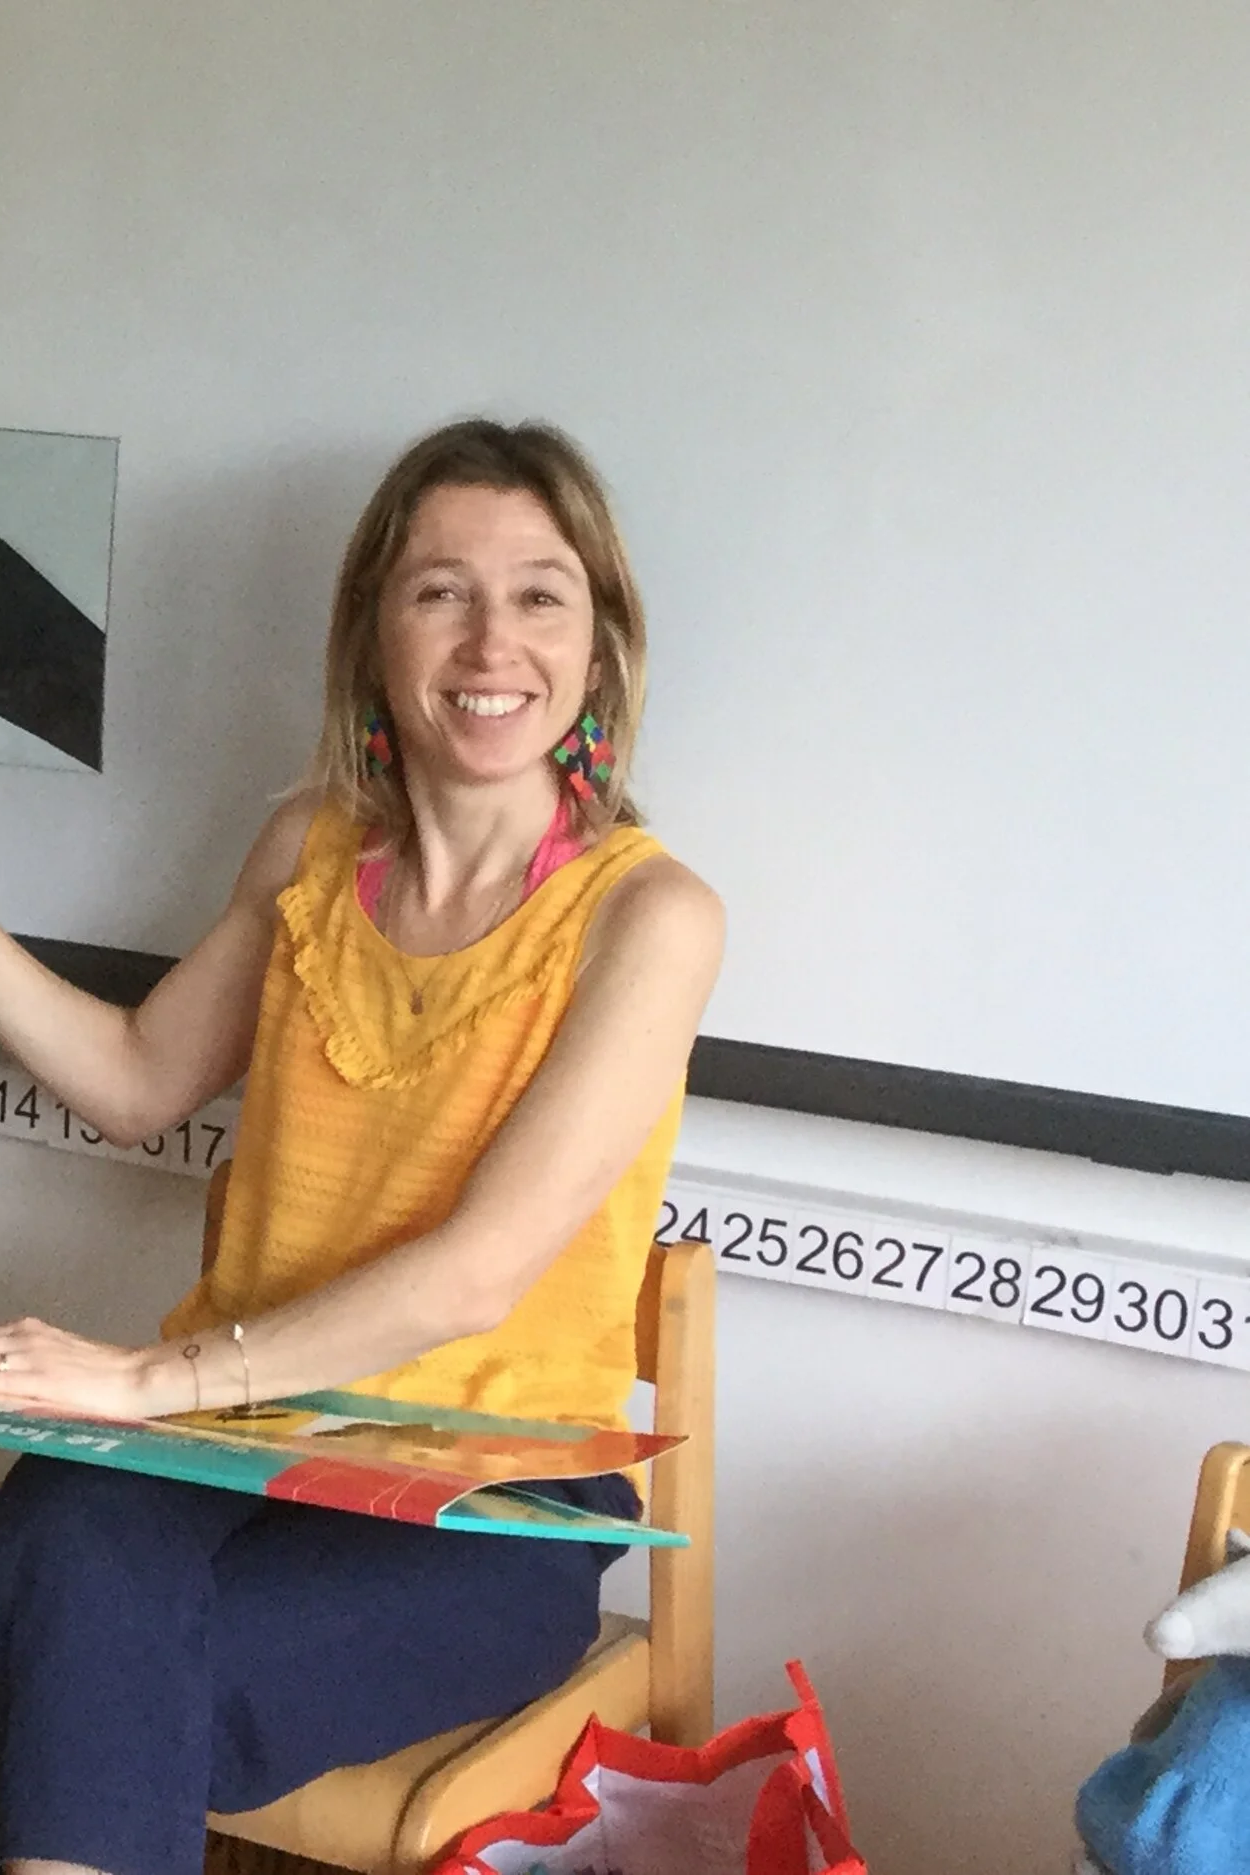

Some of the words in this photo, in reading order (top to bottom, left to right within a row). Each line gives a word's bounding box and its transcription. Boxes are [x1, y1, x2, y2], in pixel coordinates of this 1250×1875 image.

[175, 1120, 226, 1168] 17
[654, 1200, 712, 1248] 24
[721, 1212, 788, 1267] 25
[796, 1225, 864, 1280] 26
[872, 1238, 944, 1292] 27
[950, 1251, 1021, 1308] 28
[1030, 1265, 1105, 1323] 29
[1114, 1281, 1188, 1341] 30
[1198, 1298, 1250, 1350] 3
